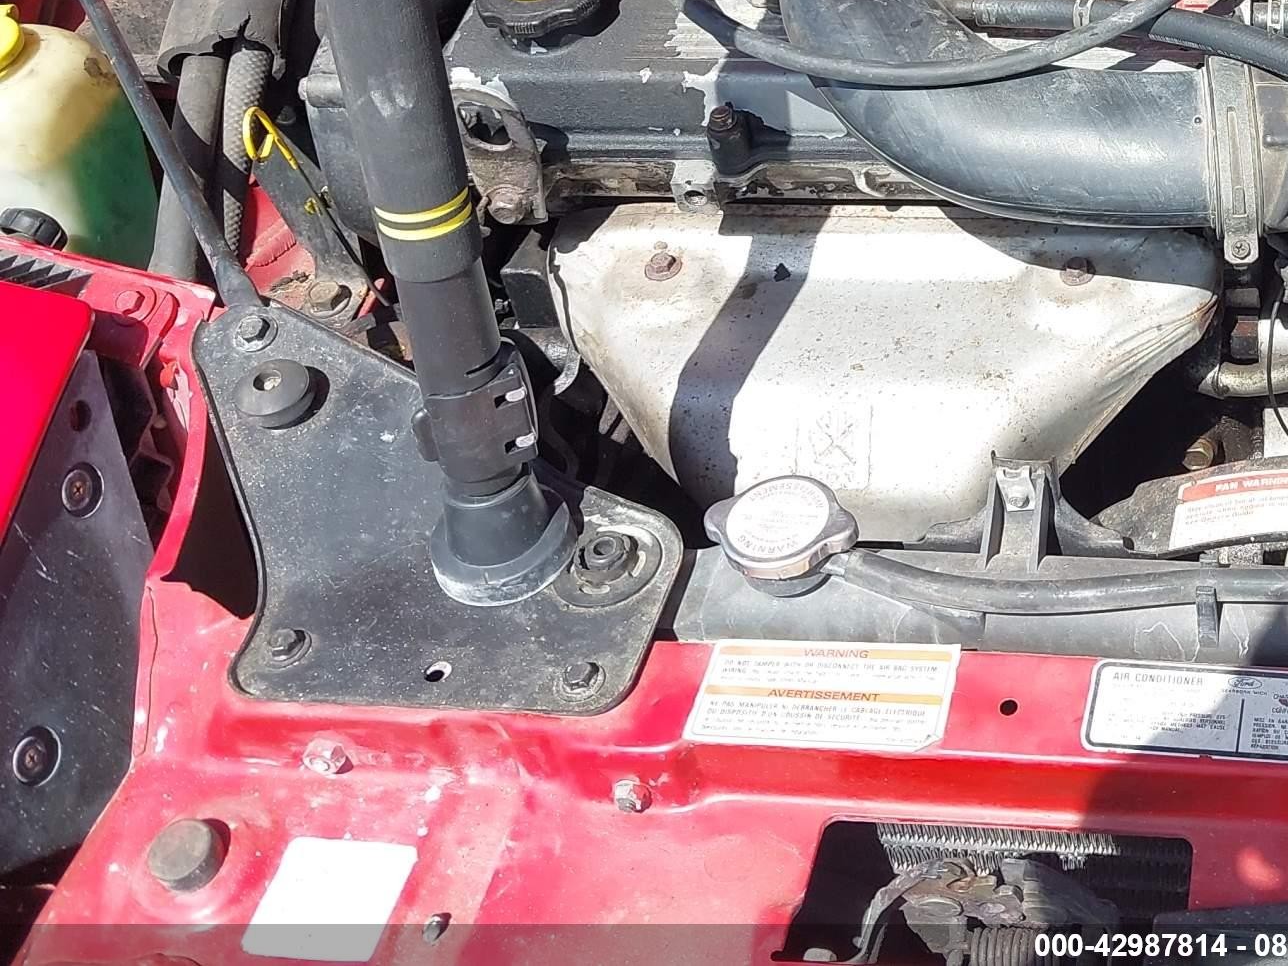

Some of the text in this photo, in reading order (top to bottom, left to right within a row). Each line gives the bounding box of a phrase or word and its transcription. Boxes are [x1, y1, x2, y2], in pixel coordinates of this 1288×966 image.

[1214, 481, 1240, 493] FAN
[804, 648, 870, 659] WARNING
[1113, 672, 1203, 686] AIR CONDITIONER
[768, 688, 880, 702] AVERTISSEMENT
